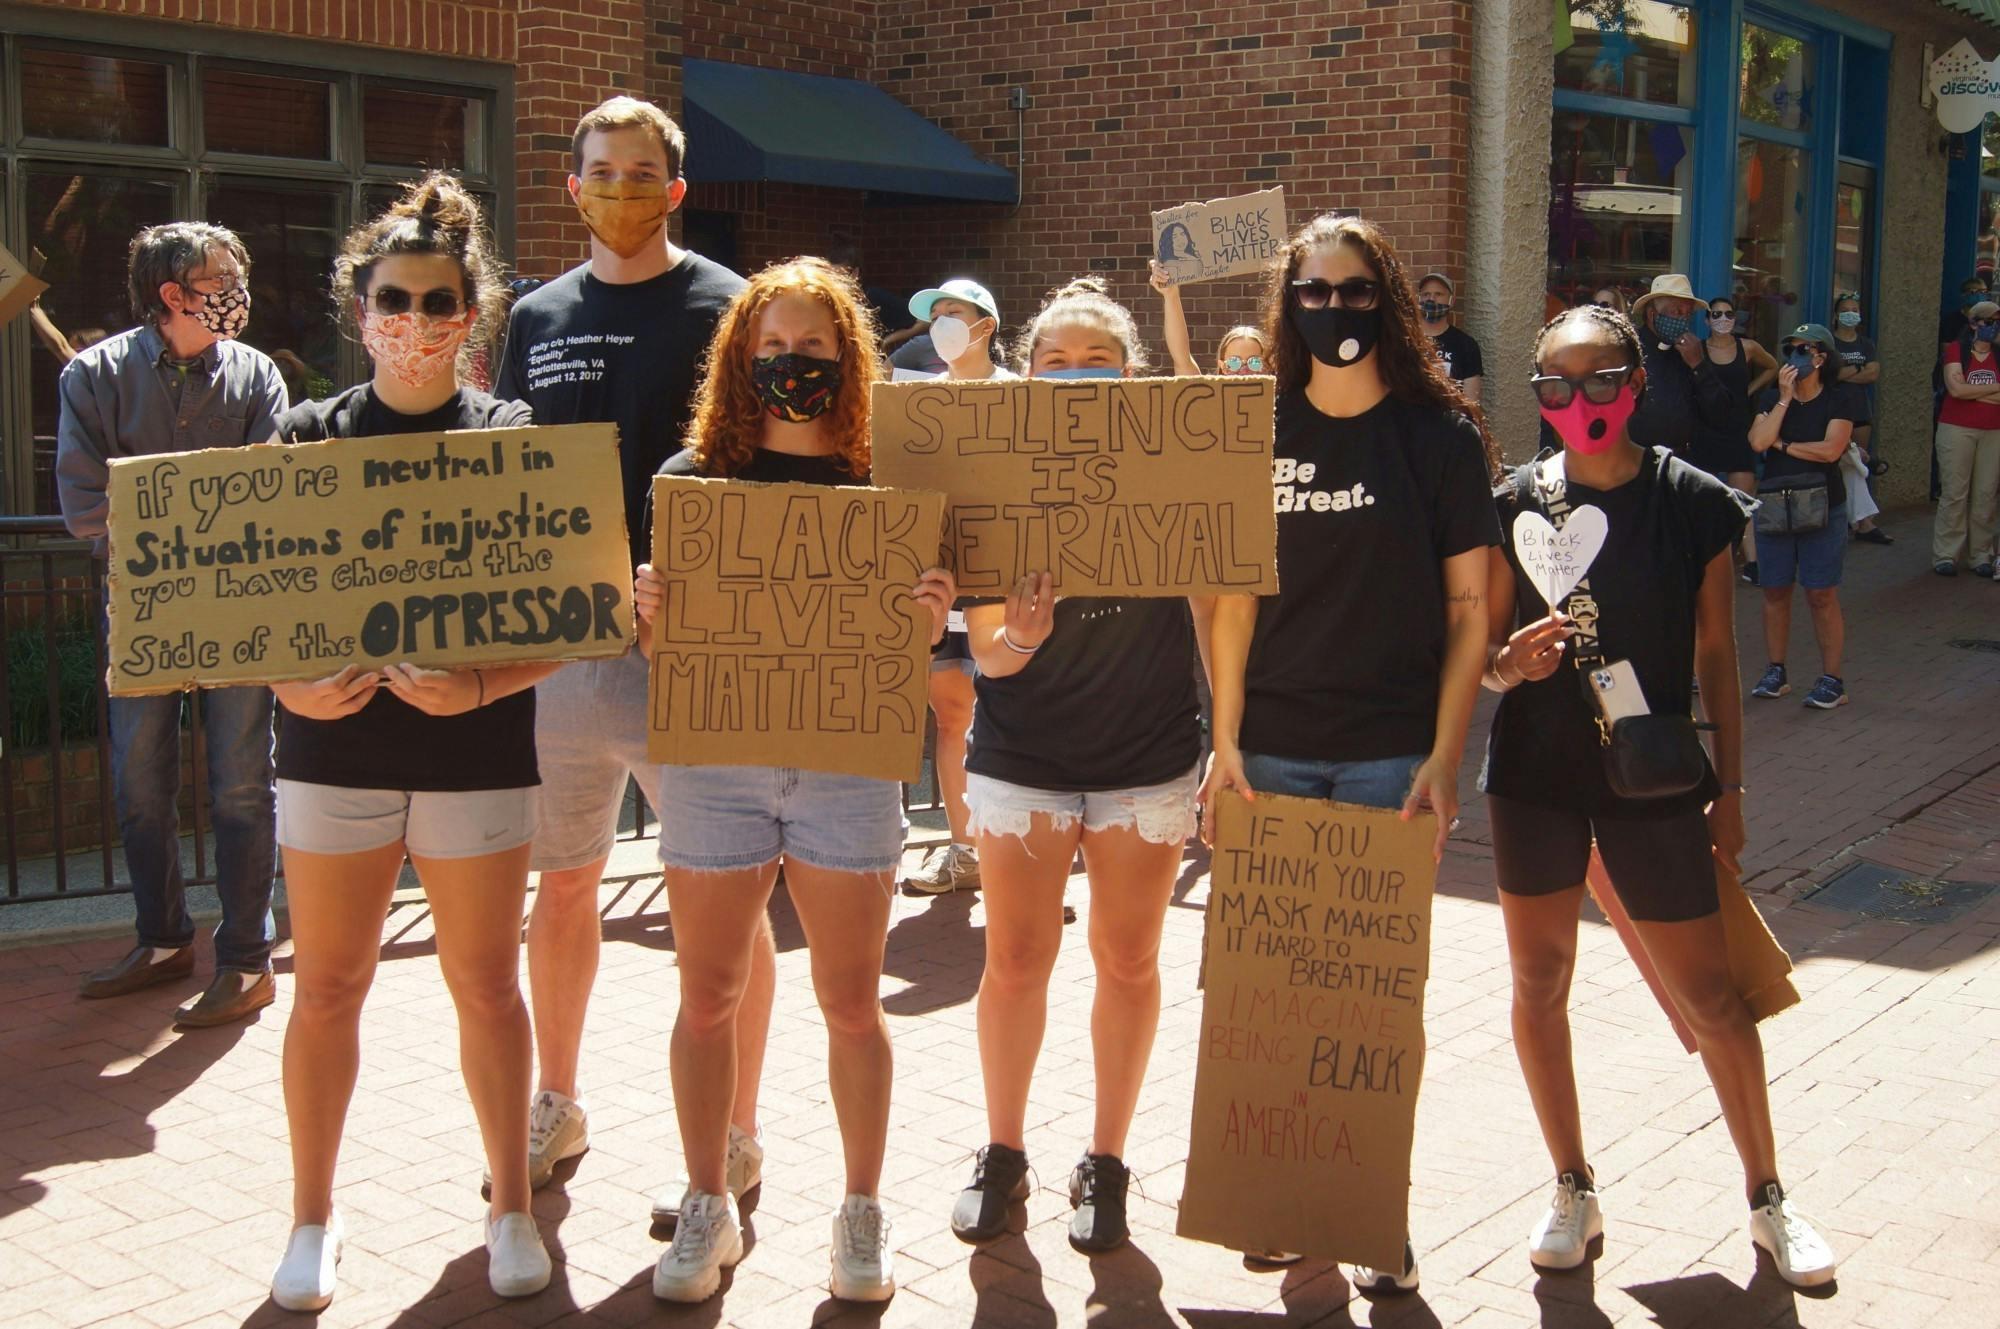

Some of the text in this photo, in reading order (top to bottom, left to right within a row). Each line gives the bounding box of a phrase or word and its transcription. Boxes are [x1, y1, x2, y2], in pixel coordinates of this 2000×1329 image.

[1940, 81, 2000, 95] discov
[1210, 207, 1270, 234] BLACK
[1221, 224, 1270, 247] LIVES
[1212, 239, 1279, 264] MATTER
[529, 342, 549, 354] Unity
[566, 334, 603, 345] Heather
[605, 334, 635, 345] Heyer
[528, 358, 605, 379] Charlottesville, VA
[534, 374, 562, 388] August
[564, 372, 578, 382] 12,
[579, 371, 603, 381] 2017
[903, 383, 1264, 456] SILENCE
[190, 454, 338, 533] you're
[363, 441, 504, 488] neutral
[521, 441, 554, 471] in
[1031, 455, 1118, 505] IS
[1274, 458, 1316, 484] Be
[1274, 482, 1375, 513] Great.
[361, 508, 405, 551] of
[421, 492, 592, 563] injustice
[668, 490, 924, 581] BLACK
[1523, 529, 1581, 546] Black
[1528, 551, 1573, 561] Lives
[1536, 563, 1580, 576] Matter
[131, 543, 553, 621] you have chosen the
[233, 626, 271, 664] of
[290, 623, 356, 661] the
[360, 582, 623, 658] OPPRESSOR
[665, 580, 918, 650] LIVES
[654, 651, 916, 734] MATTER
[1250, 816, 1370, 858] IF YOU
[1225, 849, 1406, 905] THINK YOUR
[1220, 892, 1421, 946] MASK MAKES
[1226, 927, 1351, 959] IT HARD TO
[1289, 957, 1417, 1007] BREATHE,
[1207, 1024, 1407, 1095] BEING BLACK
[1292, 1091, 1308, 1109] IN
[1221, 1099, 1361, 1167] AMERICA.
